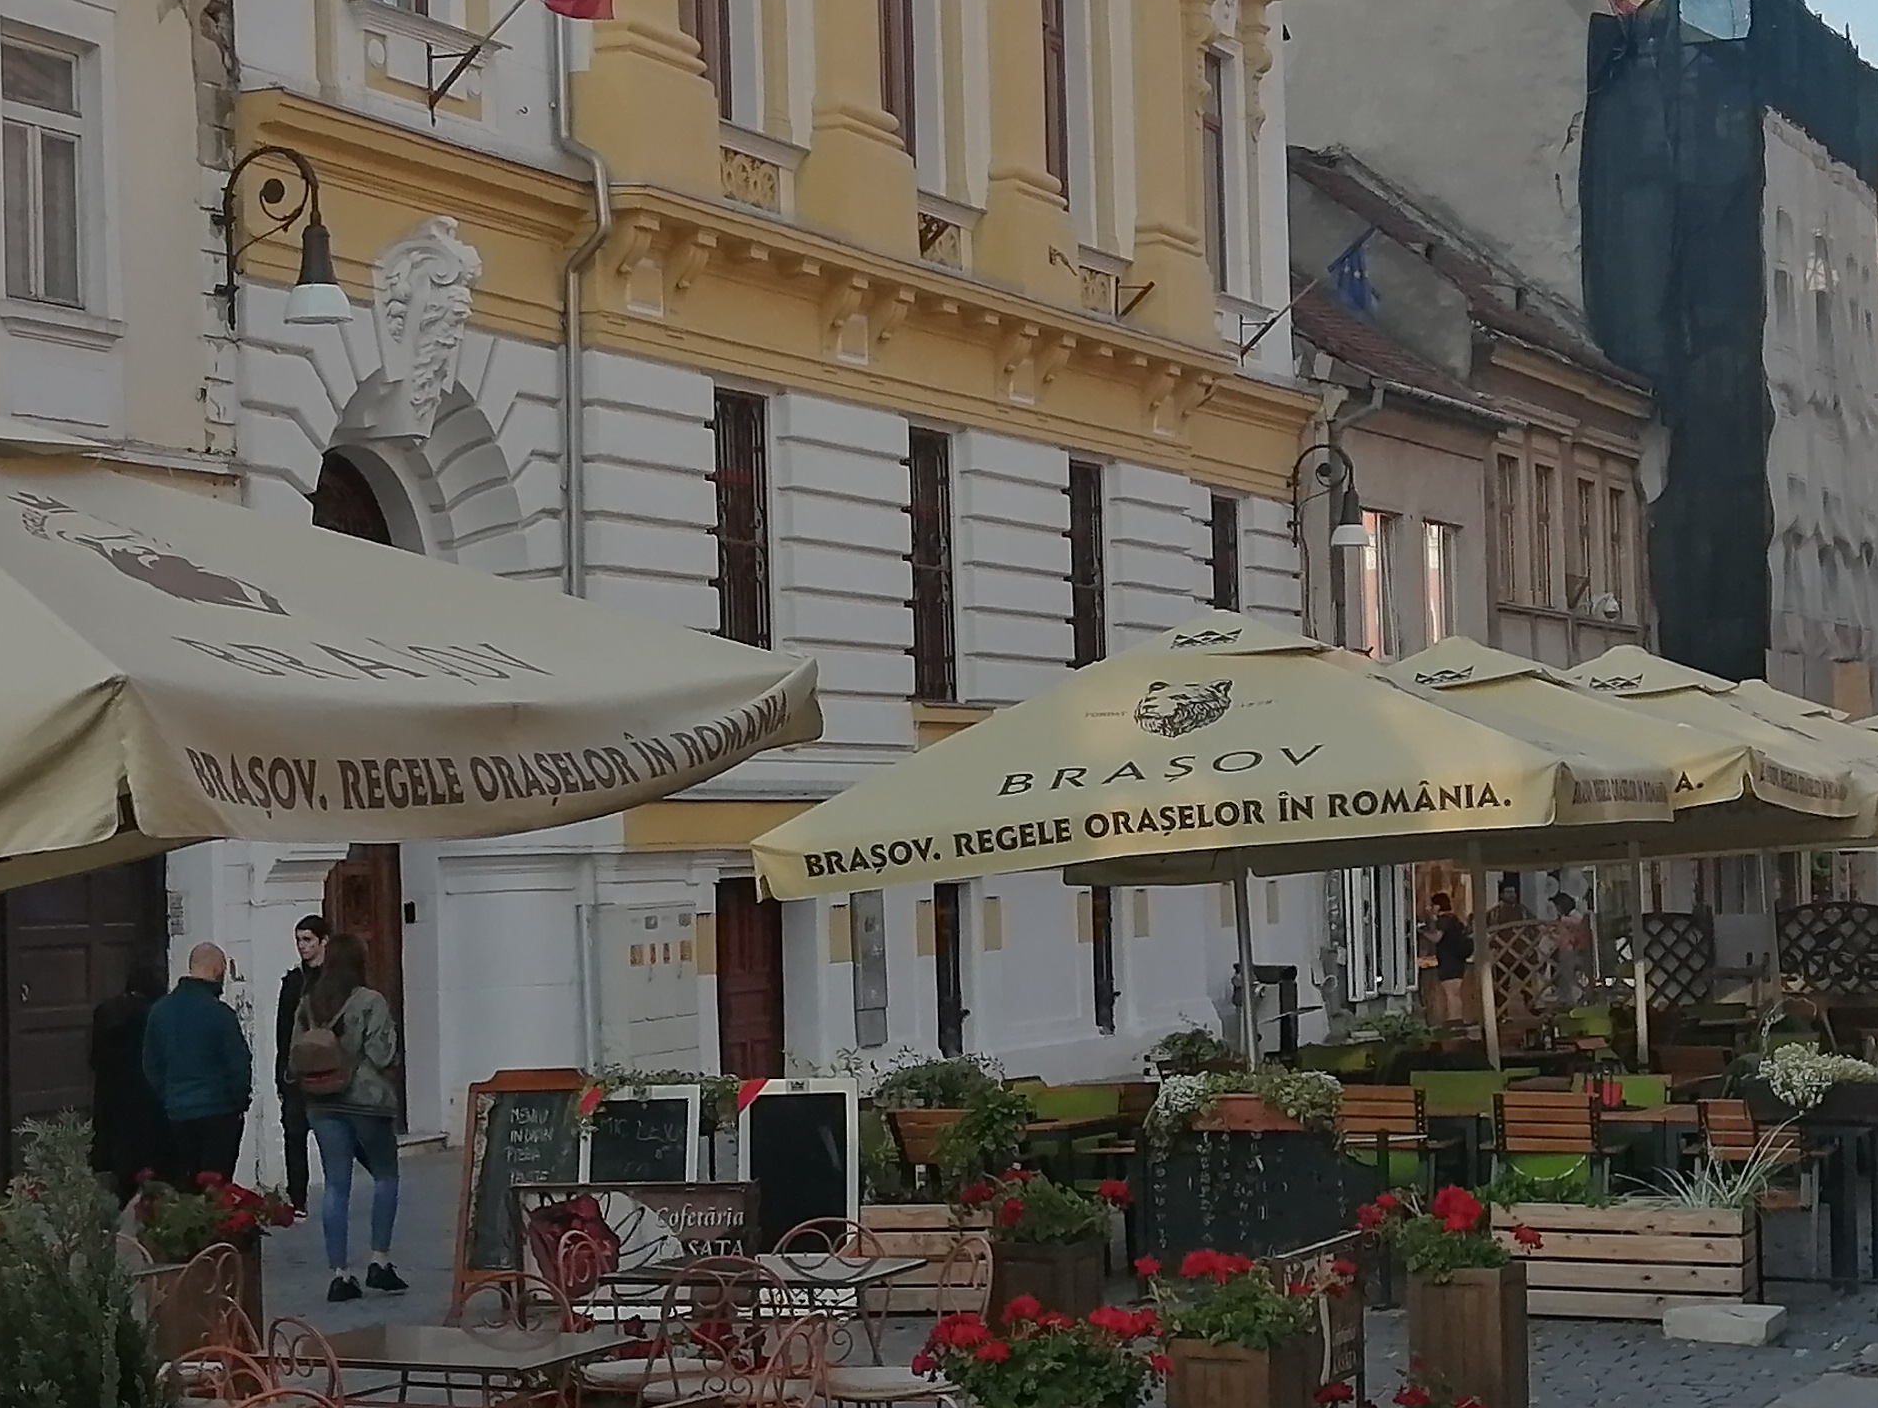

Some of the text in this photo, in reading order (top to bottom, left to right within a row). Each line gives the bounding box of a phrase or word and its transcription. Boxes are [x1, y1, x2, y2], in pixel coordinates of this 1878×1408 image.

[183, 746, 329, 820] BRAȘOV.
[336, 755, 466, 810] REGELE
[469, 747, 641, 807] ORAȘELOR
[623, 732, 678, 780] ÎN
[996, 743, 1324, 798] BRAȘOV
[803, 780, 1512, 879] BRAȘOV. REGELE ORAȘELOR ÎN ROMÂNIA.
